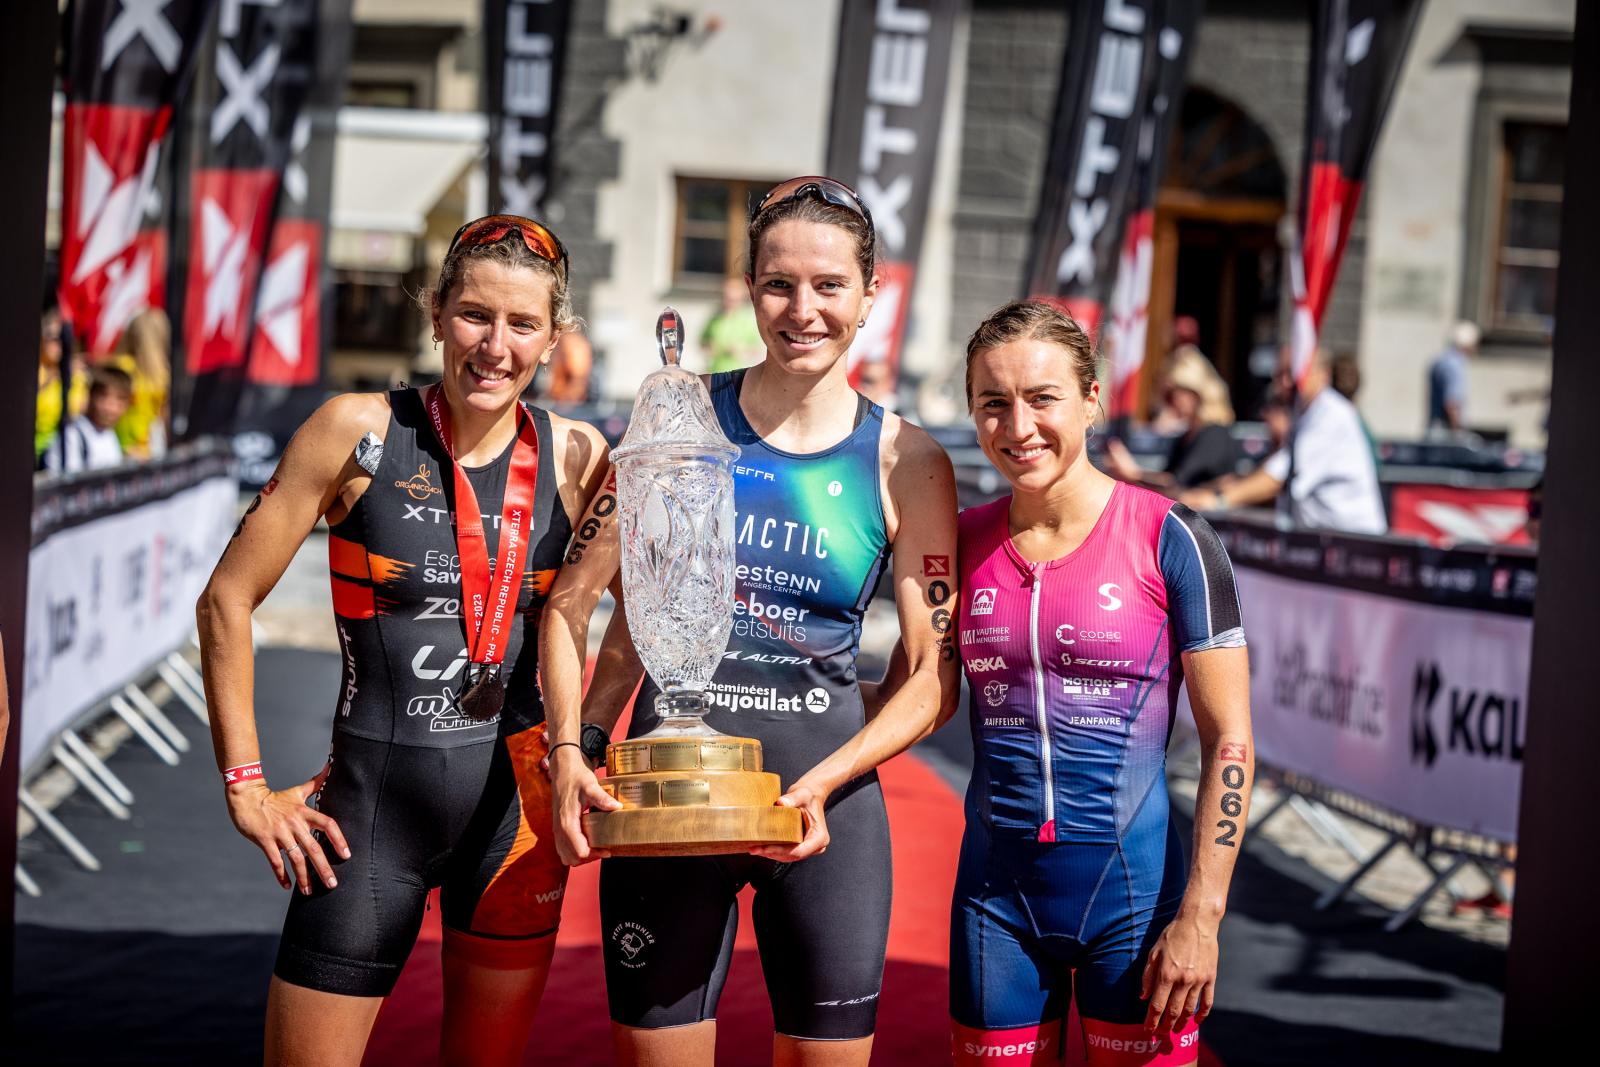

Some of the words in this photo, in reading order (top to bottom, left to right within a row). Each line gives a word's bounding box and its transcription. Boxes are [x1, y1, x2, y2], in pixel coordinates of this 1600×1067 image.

[500, 0, 554, 216] XTER
[857, 0, 934, 252] XTER
[1056, 0, 1149, 286] XTER
[507, 509, 522, 550] XTERRA
[733, 512, 829, 559] ACTIC
[501, 550, 516, 583] CZECH
[742, 581, 772, 591] ANGERS
[773, 585, 802, 596] CENTRE
[473, 594, 483, 618] 2023
[491, 585, 510, 635] REPUBLIC
[733, 592, 810, 623] eboer
[732, 616, 807, 643] etsuits
[976, 627, 1010, 635] VAUTHIER
[976, 635, 1010, 644] MENUISERIE
[1080, 631, 1121, 640] CODEC
[741, 653, 813, 665] ALTRA
[967, 656, 1008, 673] HOKA
[1073, 658, 1135, 667] SCOTT
[1063, 677, 1112, 688] MOTION
[1084, 686, 1111, 696] LAB
[1069, 716, 1121, 726] JEANFAVRE
[1215, 764, 1245, 848] 062
[535, 883, 564, 904] wah
[612, 923, 624, 941] PETIT
[624, 921, 656, 945] MEUNIER
[965, 1037, 1050, 1058] synergy
[1088, 1033, 1162, 1053] synergy
